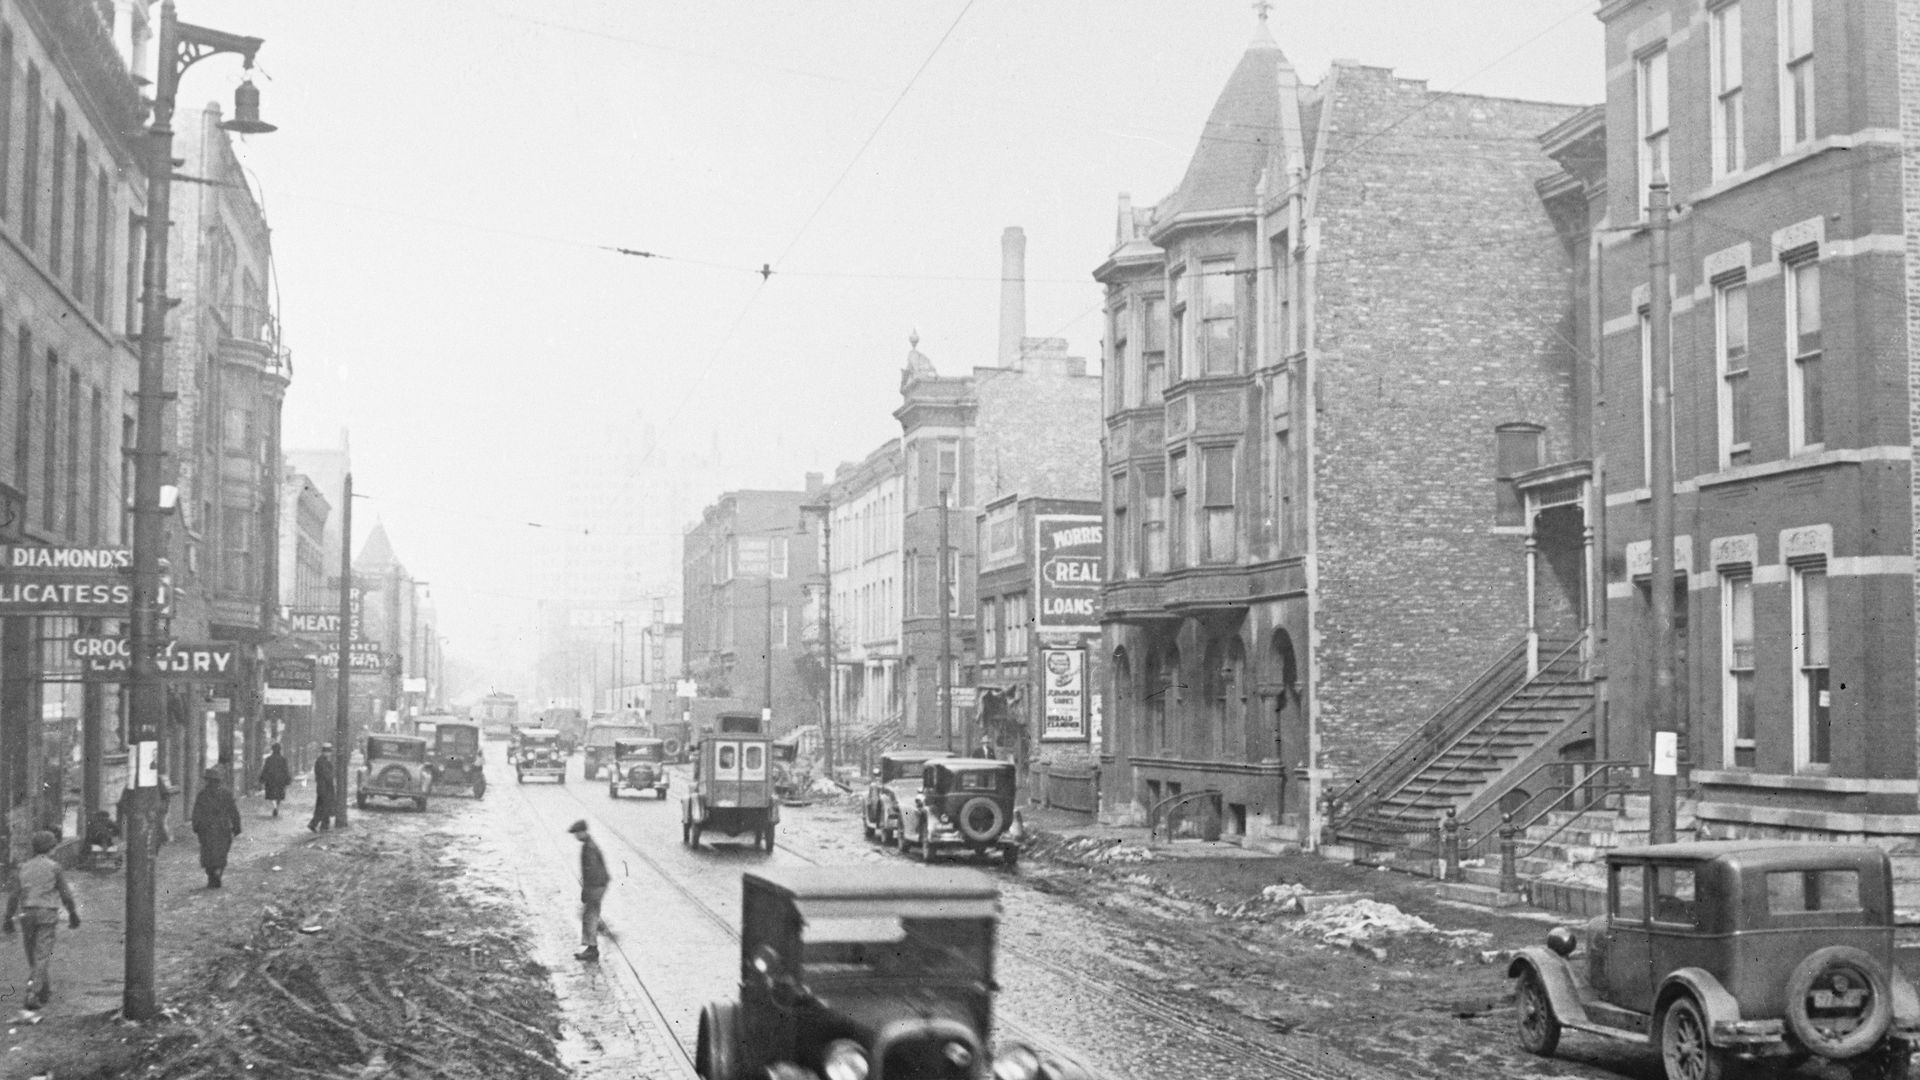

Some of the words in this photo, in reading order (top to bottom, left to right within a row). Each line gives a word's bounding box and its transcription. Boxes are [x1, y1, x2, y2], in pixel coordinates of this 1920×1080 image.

[1053, 526, 1102, 549] MORRIS
[13, 548, 129, 567] DIAMOND'S
[1056, 562, 1102, 582] REAL
[0, 584, 129, 603] LICATESS
